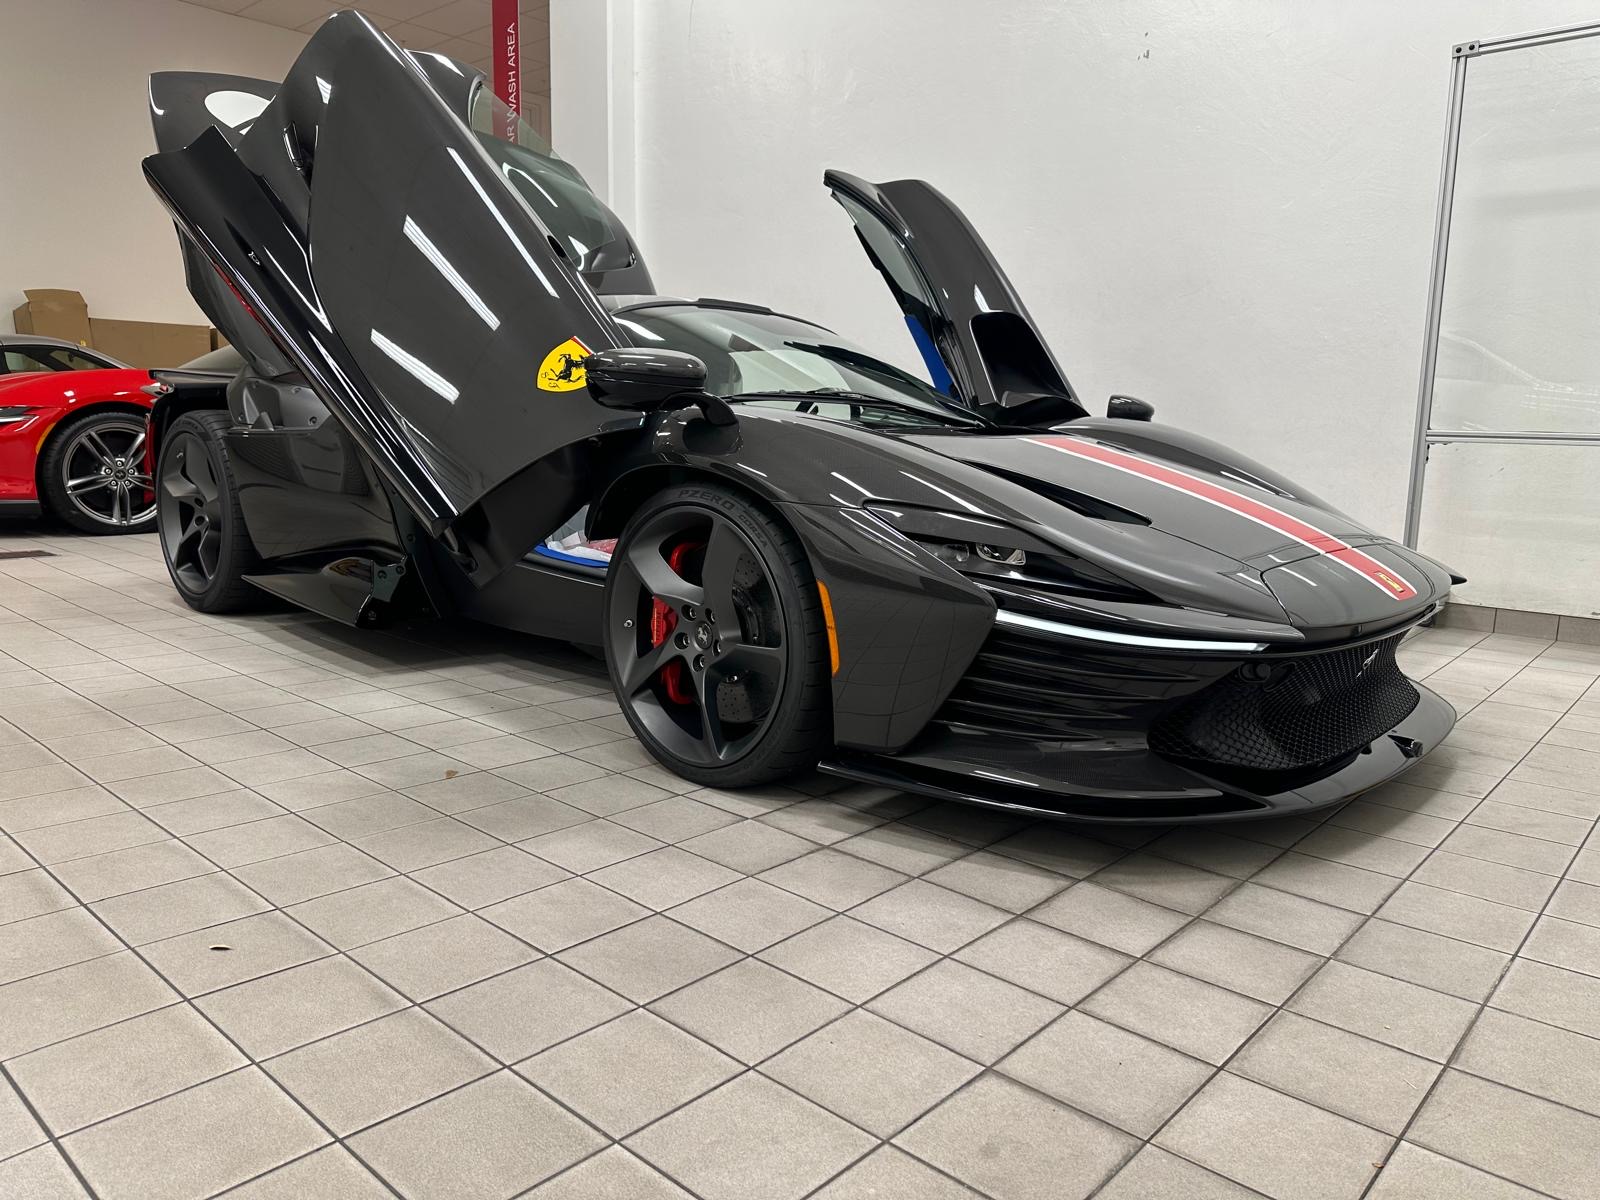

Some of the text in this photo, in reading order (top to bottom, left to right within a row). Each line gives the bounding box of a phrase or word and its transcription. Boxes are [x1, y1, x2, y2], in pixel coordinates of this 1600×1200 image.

[507, 22, 517, 143] AR WASH AREA
